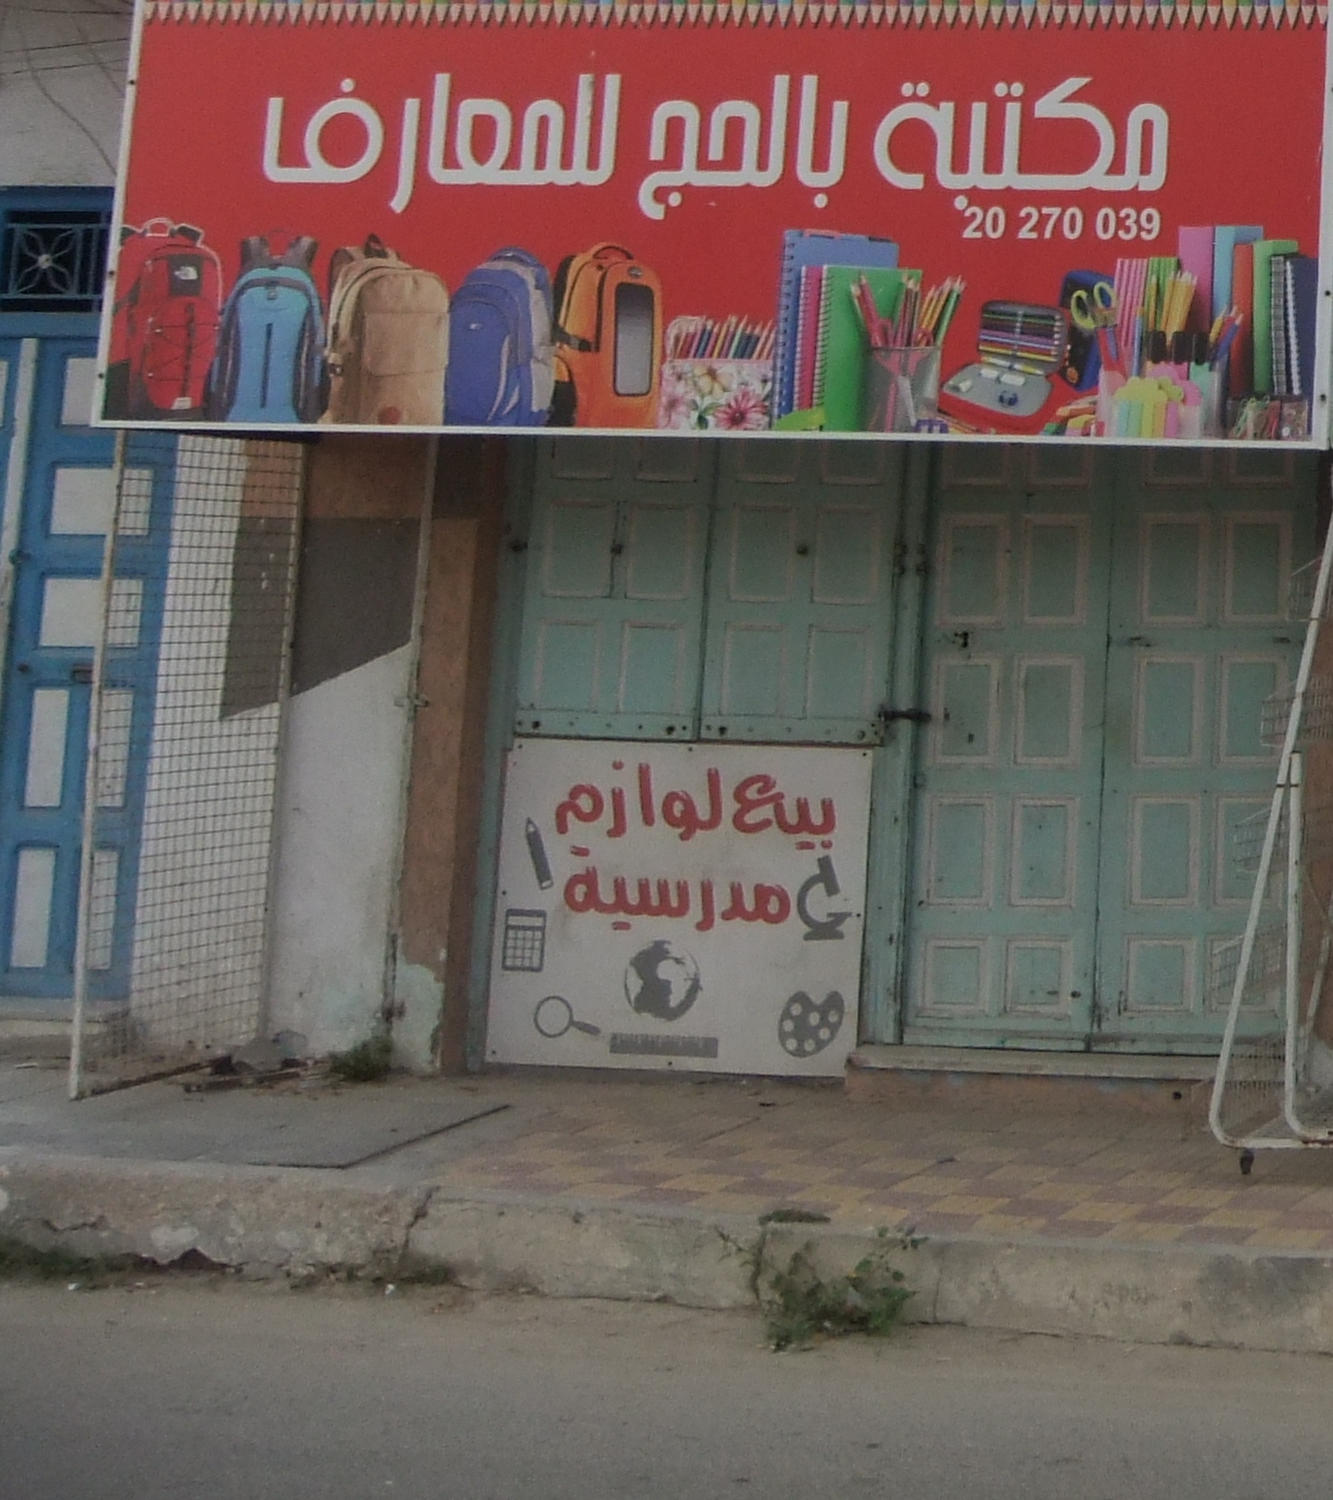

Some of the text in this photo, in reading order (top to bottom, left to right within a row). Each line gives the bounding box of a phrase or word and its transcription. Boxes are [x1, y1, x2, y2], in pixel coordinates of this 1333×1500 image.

[262, 72, 1169, 221] مكتبة بالحج للمعارف
[961, 206, 1162, 241] 20 270 039
[555, 760, 837, 851] بيع لوازم
[563, 845, 792, 932] مدرسية
